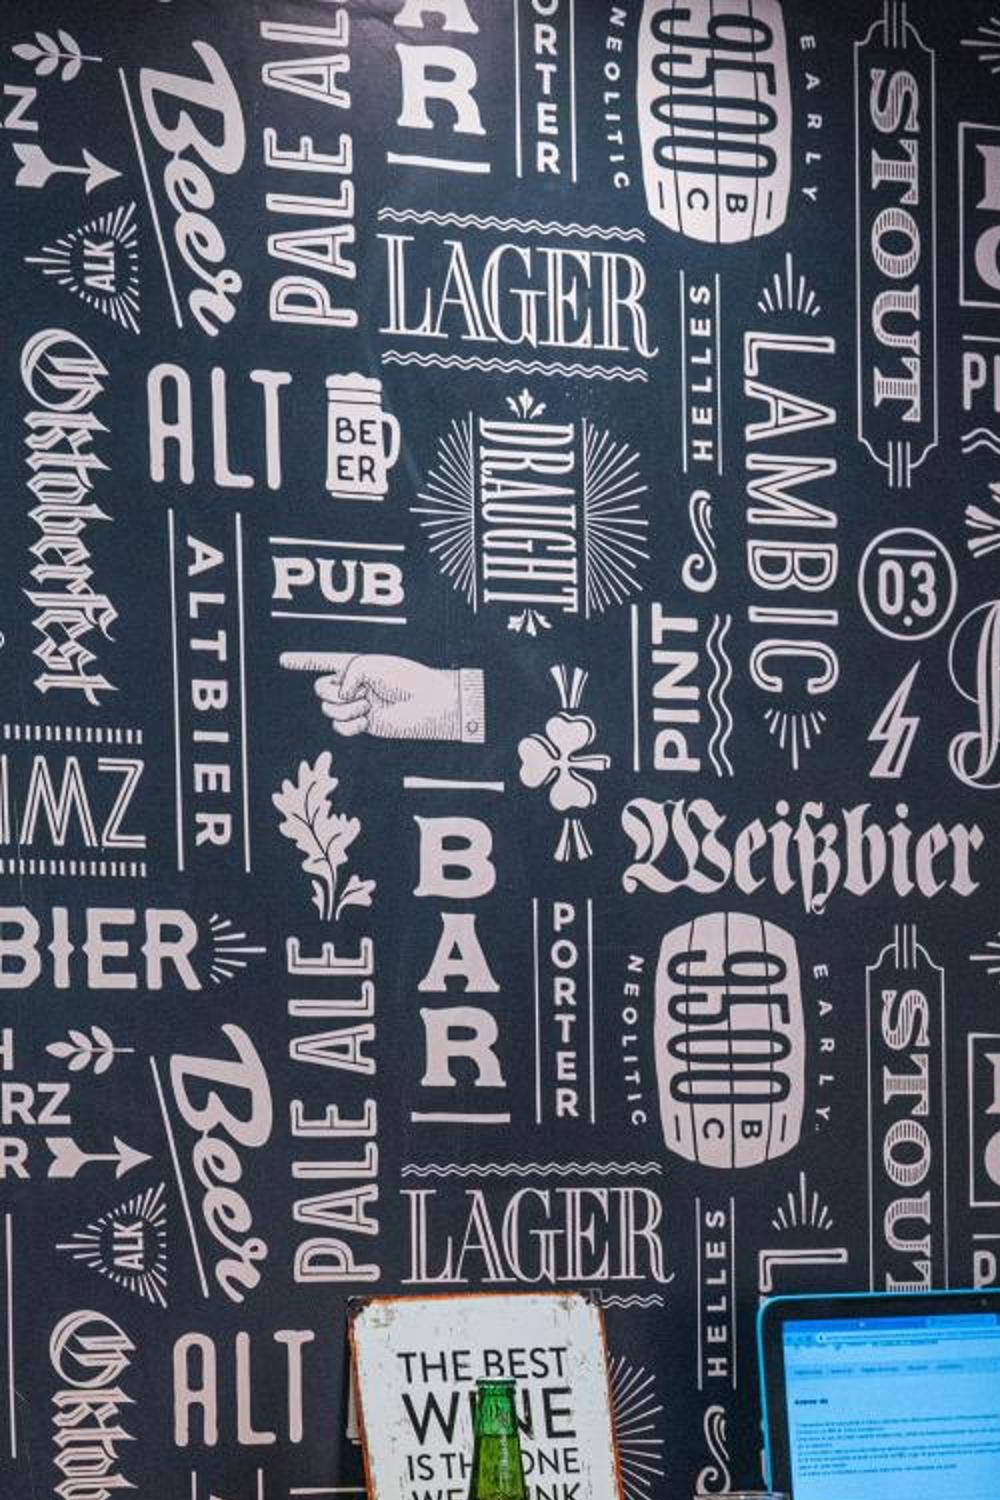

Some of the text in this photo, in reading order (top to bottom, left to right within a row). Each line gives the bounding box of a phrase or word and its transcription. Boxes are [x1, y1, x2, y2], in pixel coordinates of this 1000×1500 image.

[260, 8, 359, 328] PALE AL
[531, 0, 561, 175] ORTER
[603, 7, 631, 189] NEOLITIC
[648, 8, 778, 182] 9500
[799, 35, 823, 202] EARLY
[83, 238, 116, 293] ALK
[137, 40, 247, 337] Beer
[869, 68, 922, 423] STOUT
[375, 233, 659, 359] LAGER
[689, 285, 714, 461] HELLES
[146, 362, 293, 491] ALT
[334, 416, 379, 446] BE
[336, 454, 378, 484] ER
[19, 328, 119, 707] Oktoberfest
[271, 555, 405, 607] PUB
[478, 417, 579, 613] DRAUGHT
[743, 330, 840, 695] LAMBIC
[186, 535, 232, 847] ALTBIER
[651, 601, 701, 772] PINT
[621, 797, 985, 915] Weißbier
[0, 905, 203, 991] BIER
[412, 814, 507, 1088] BAR
[550, 901, 580, 1118] PORTER
[667, 949, 793, 1107] 9500
[1, 1082, 72, 1125] RZ
[285, 936, 381, 1283] PALE ALE
[621, 954, 647, 1126] NEOLITIC
[812, 963, 836, 1121] EARLY
[112, 1220, 145, 1271] ALK
[165, 1023, 273, 1304] Beer
[399, 1186, 675, 1285] LAGER
[396, 1347, 568, 1384] THE BEST
[704, 1210, 728, 1377] HELLES
[172, 1329, 316, 1447] ALT
[406, 1455, 435, 1481] IS
